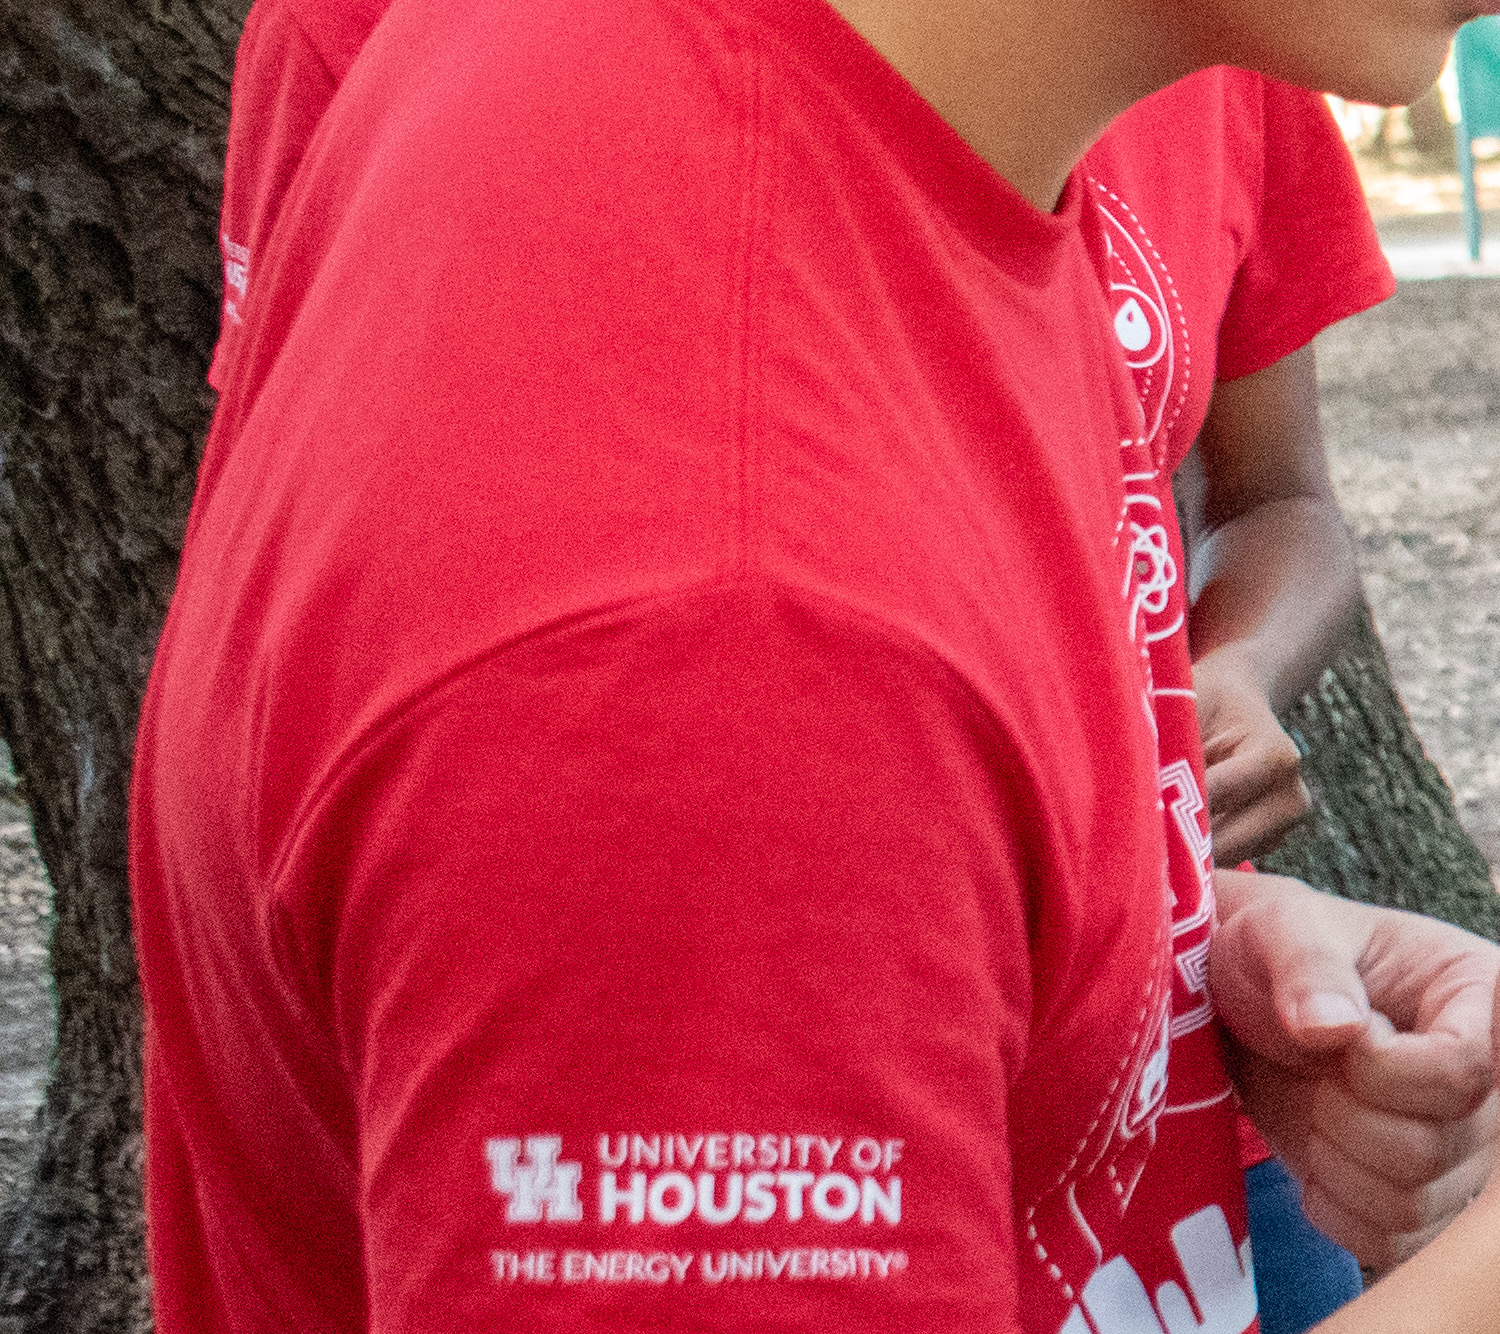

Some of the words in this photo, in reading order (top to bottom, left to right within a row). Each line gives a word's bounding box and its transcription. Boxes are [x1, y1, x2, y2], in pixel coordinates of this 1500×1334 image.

[600, 1134, 842, 1168] UNIVERSITY
[852, 1138, 903, 1172] OF
[600, 1172, 901, 1225] HOUSTON
[492, 1250, 556, 1282] THE
[562, 1250, 694, 1283] ENERGY
